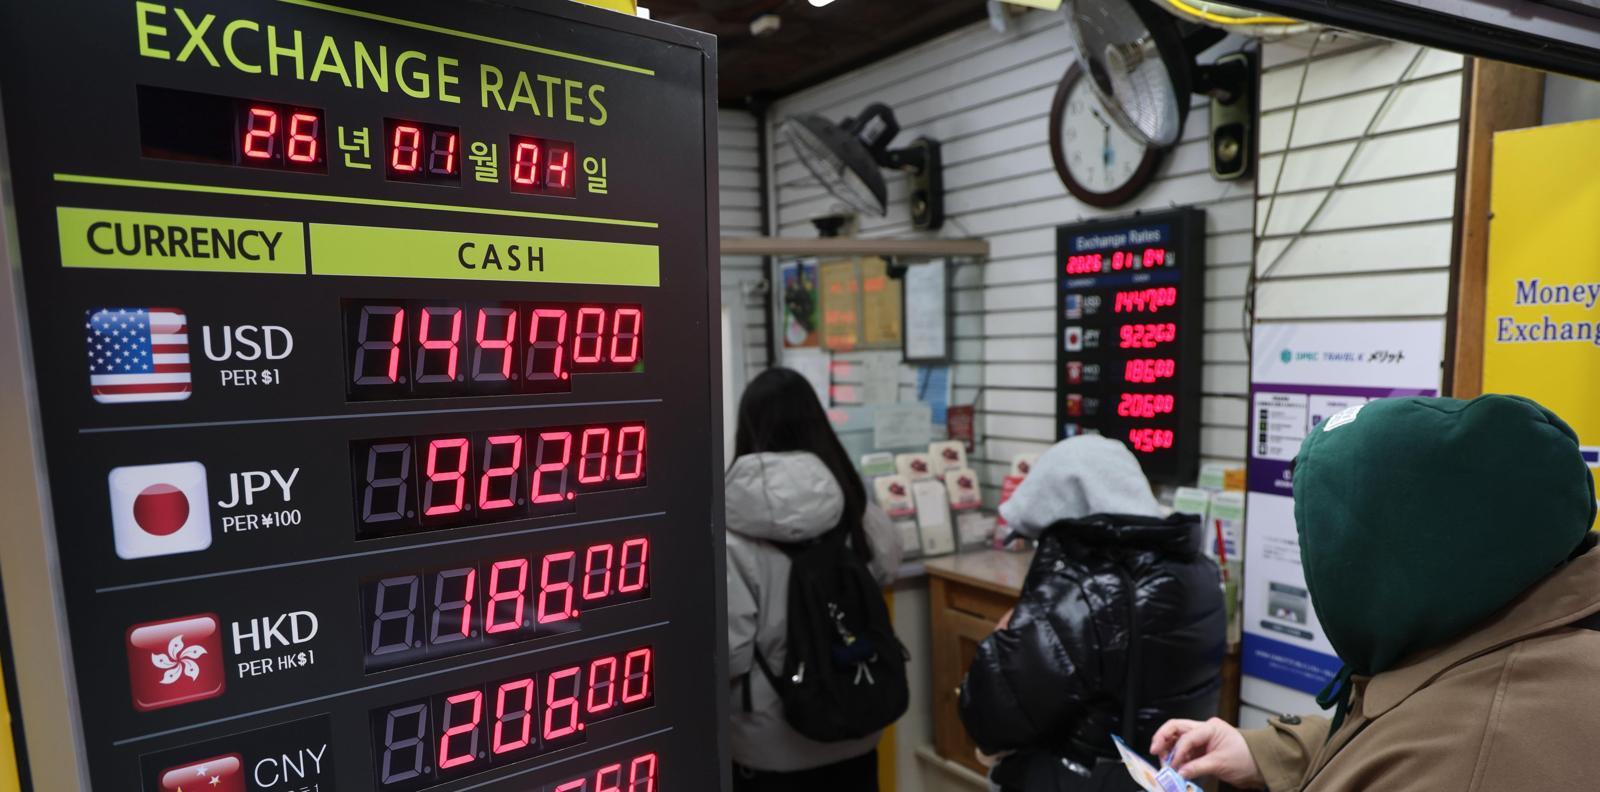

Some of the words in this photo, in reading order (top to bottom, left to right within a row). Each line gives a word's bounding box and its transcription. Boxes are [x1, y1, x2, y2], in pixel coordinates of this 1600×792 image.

[136, 1, 462, 104] EXCHANGE
[481, 70, 609, 127] RATES
[244, 108, 318, 163] 26
[338, 127, 371, 169] 년
[392, 126, 455, 174] 01
[469, 141, 499, 183] 월
[583, 156, 607, 194] 일
[86, 221, 283, 261] CURRENCY
[458, 242, 545, 272] CASH
[1076, 234, 1127, 251] Exchange
[1128, 229, 1161, 245] Rates
[1516, 279, 1600, 309] Money
[202, 325, 294, 362] USD
[388, 307, 641, 383] 1447.00
[220, 370, 258, 386] PER
[261, 368, 280, 385] $1
[217, 467, 300, 509] JPY
[425, 426, 645, 517] 922.00
[221, 515, 259, 533] PER
[261, 508, 302, 530] ¥100
[461, 538, 649, 637] 186.00
[231, 610, 319, 655] HKD
[237, 658, 274, 679] PER
[277, 649, 315, 672] HK$1
[439, 648, 656, 770] 206.00
[254, 743, 327, 788] CNY
